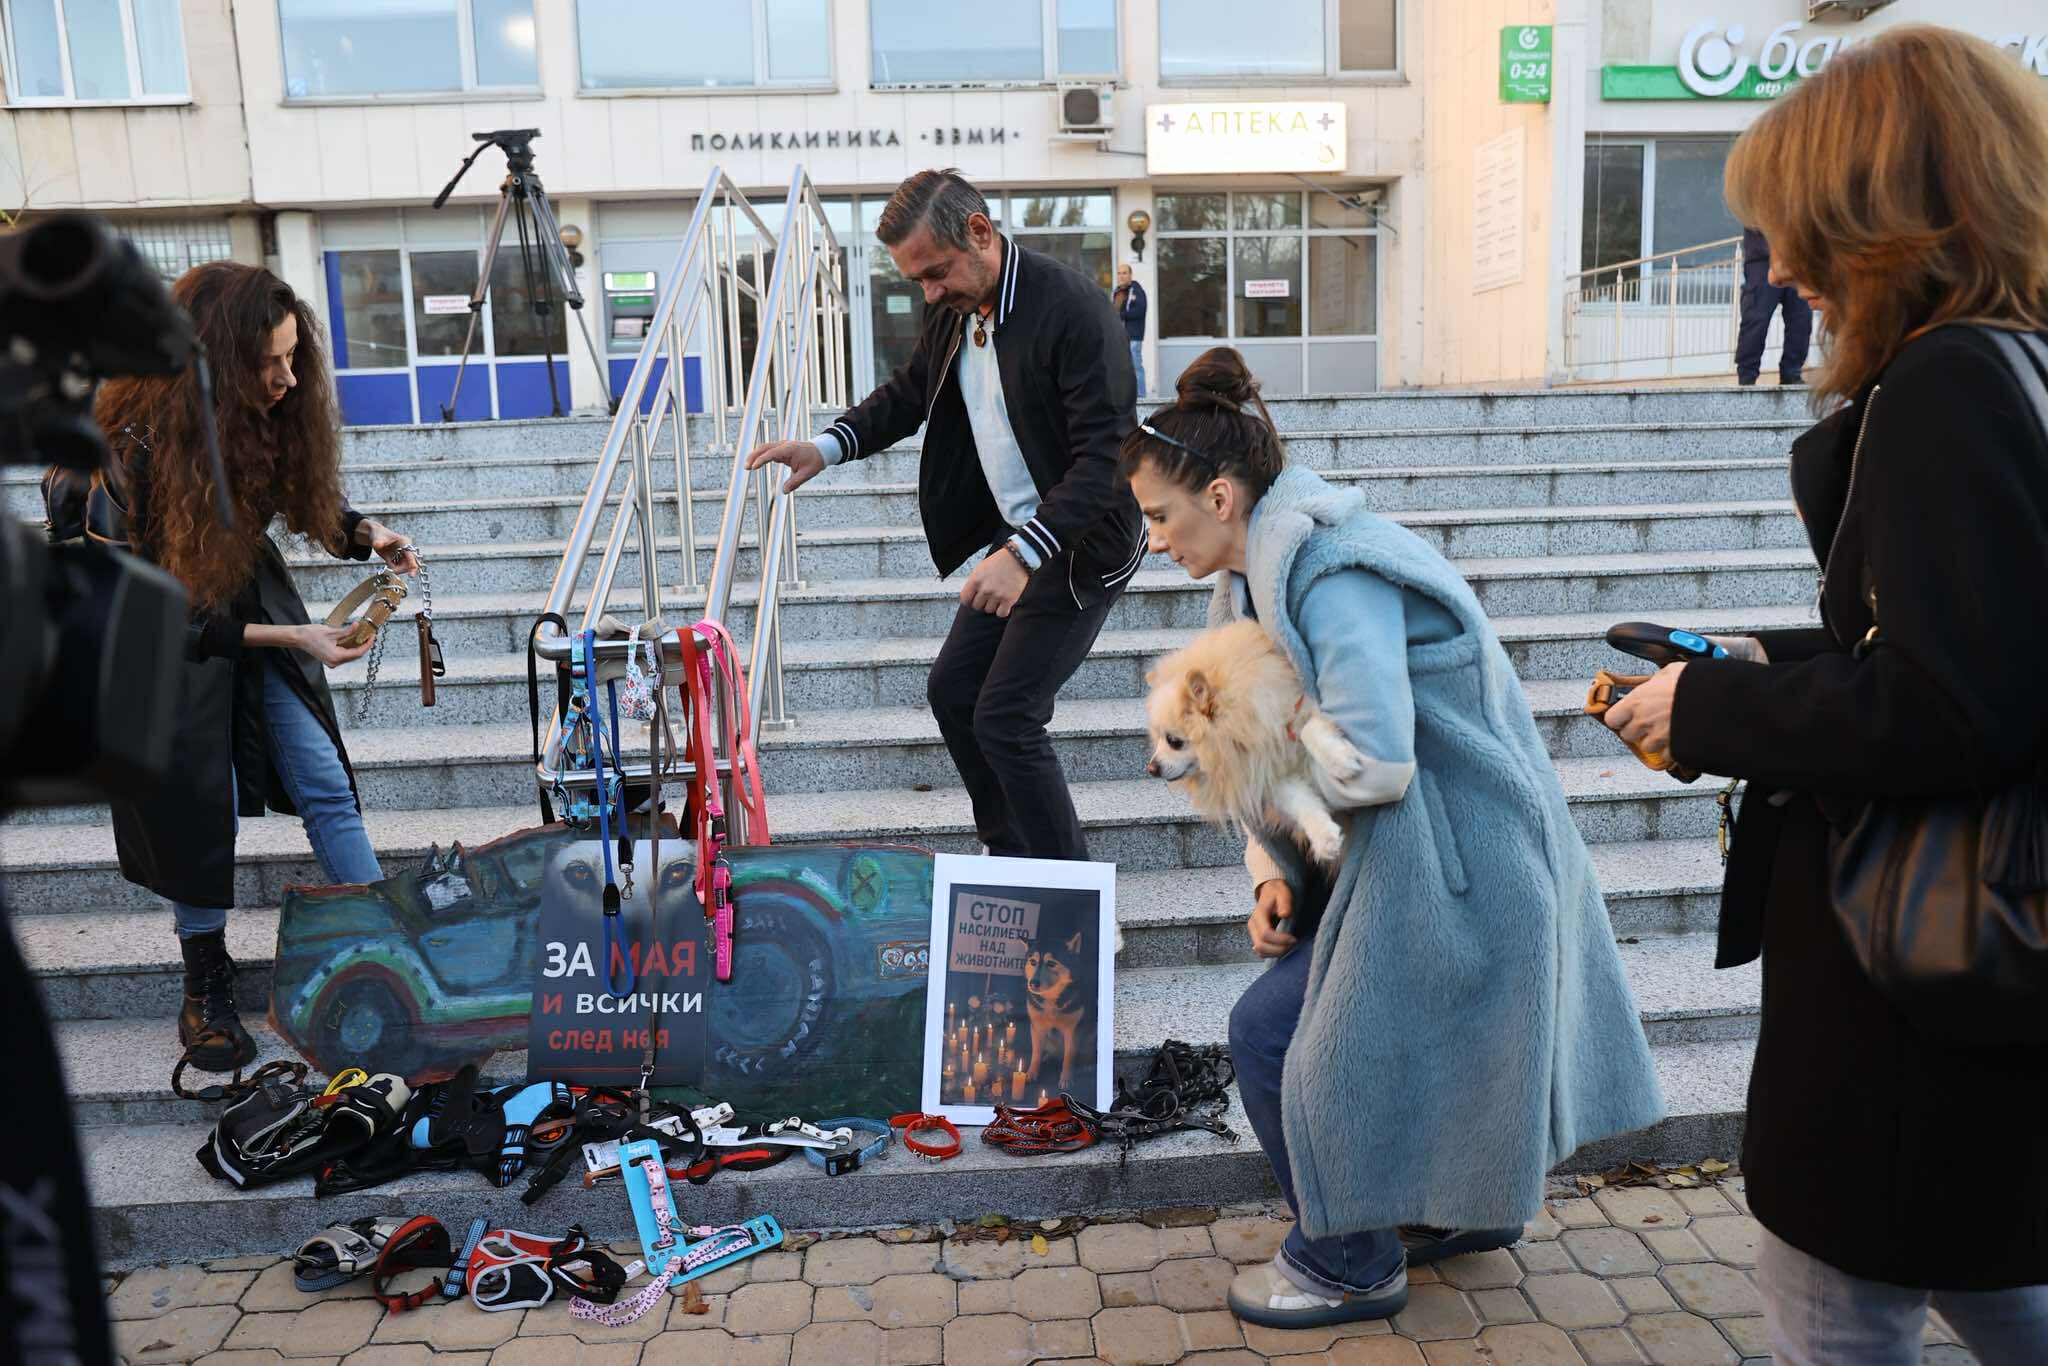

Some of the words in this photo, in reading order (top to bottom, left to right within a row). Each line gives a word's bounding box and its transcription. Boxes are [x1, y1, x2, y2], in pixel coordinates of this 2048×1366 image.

[1511, 63, 1547, 80] 0-24
[1184, 111, 1308, 134] АПТЕКА
[691, 130, 901, 151] ПОЛИКЛИНИКА
[970, 901, 1025, 926] СТОП
[959, 923, 1029, 940] НАСИЛИЕТО
[980, 940, 1006, 955] НАД
[542, 941, 596, 978] ЗА
[610, 940, 696, 977] МАЯ
[549, 1028, 613, 1052] след
[622, 1028, 670, 1049] нея
